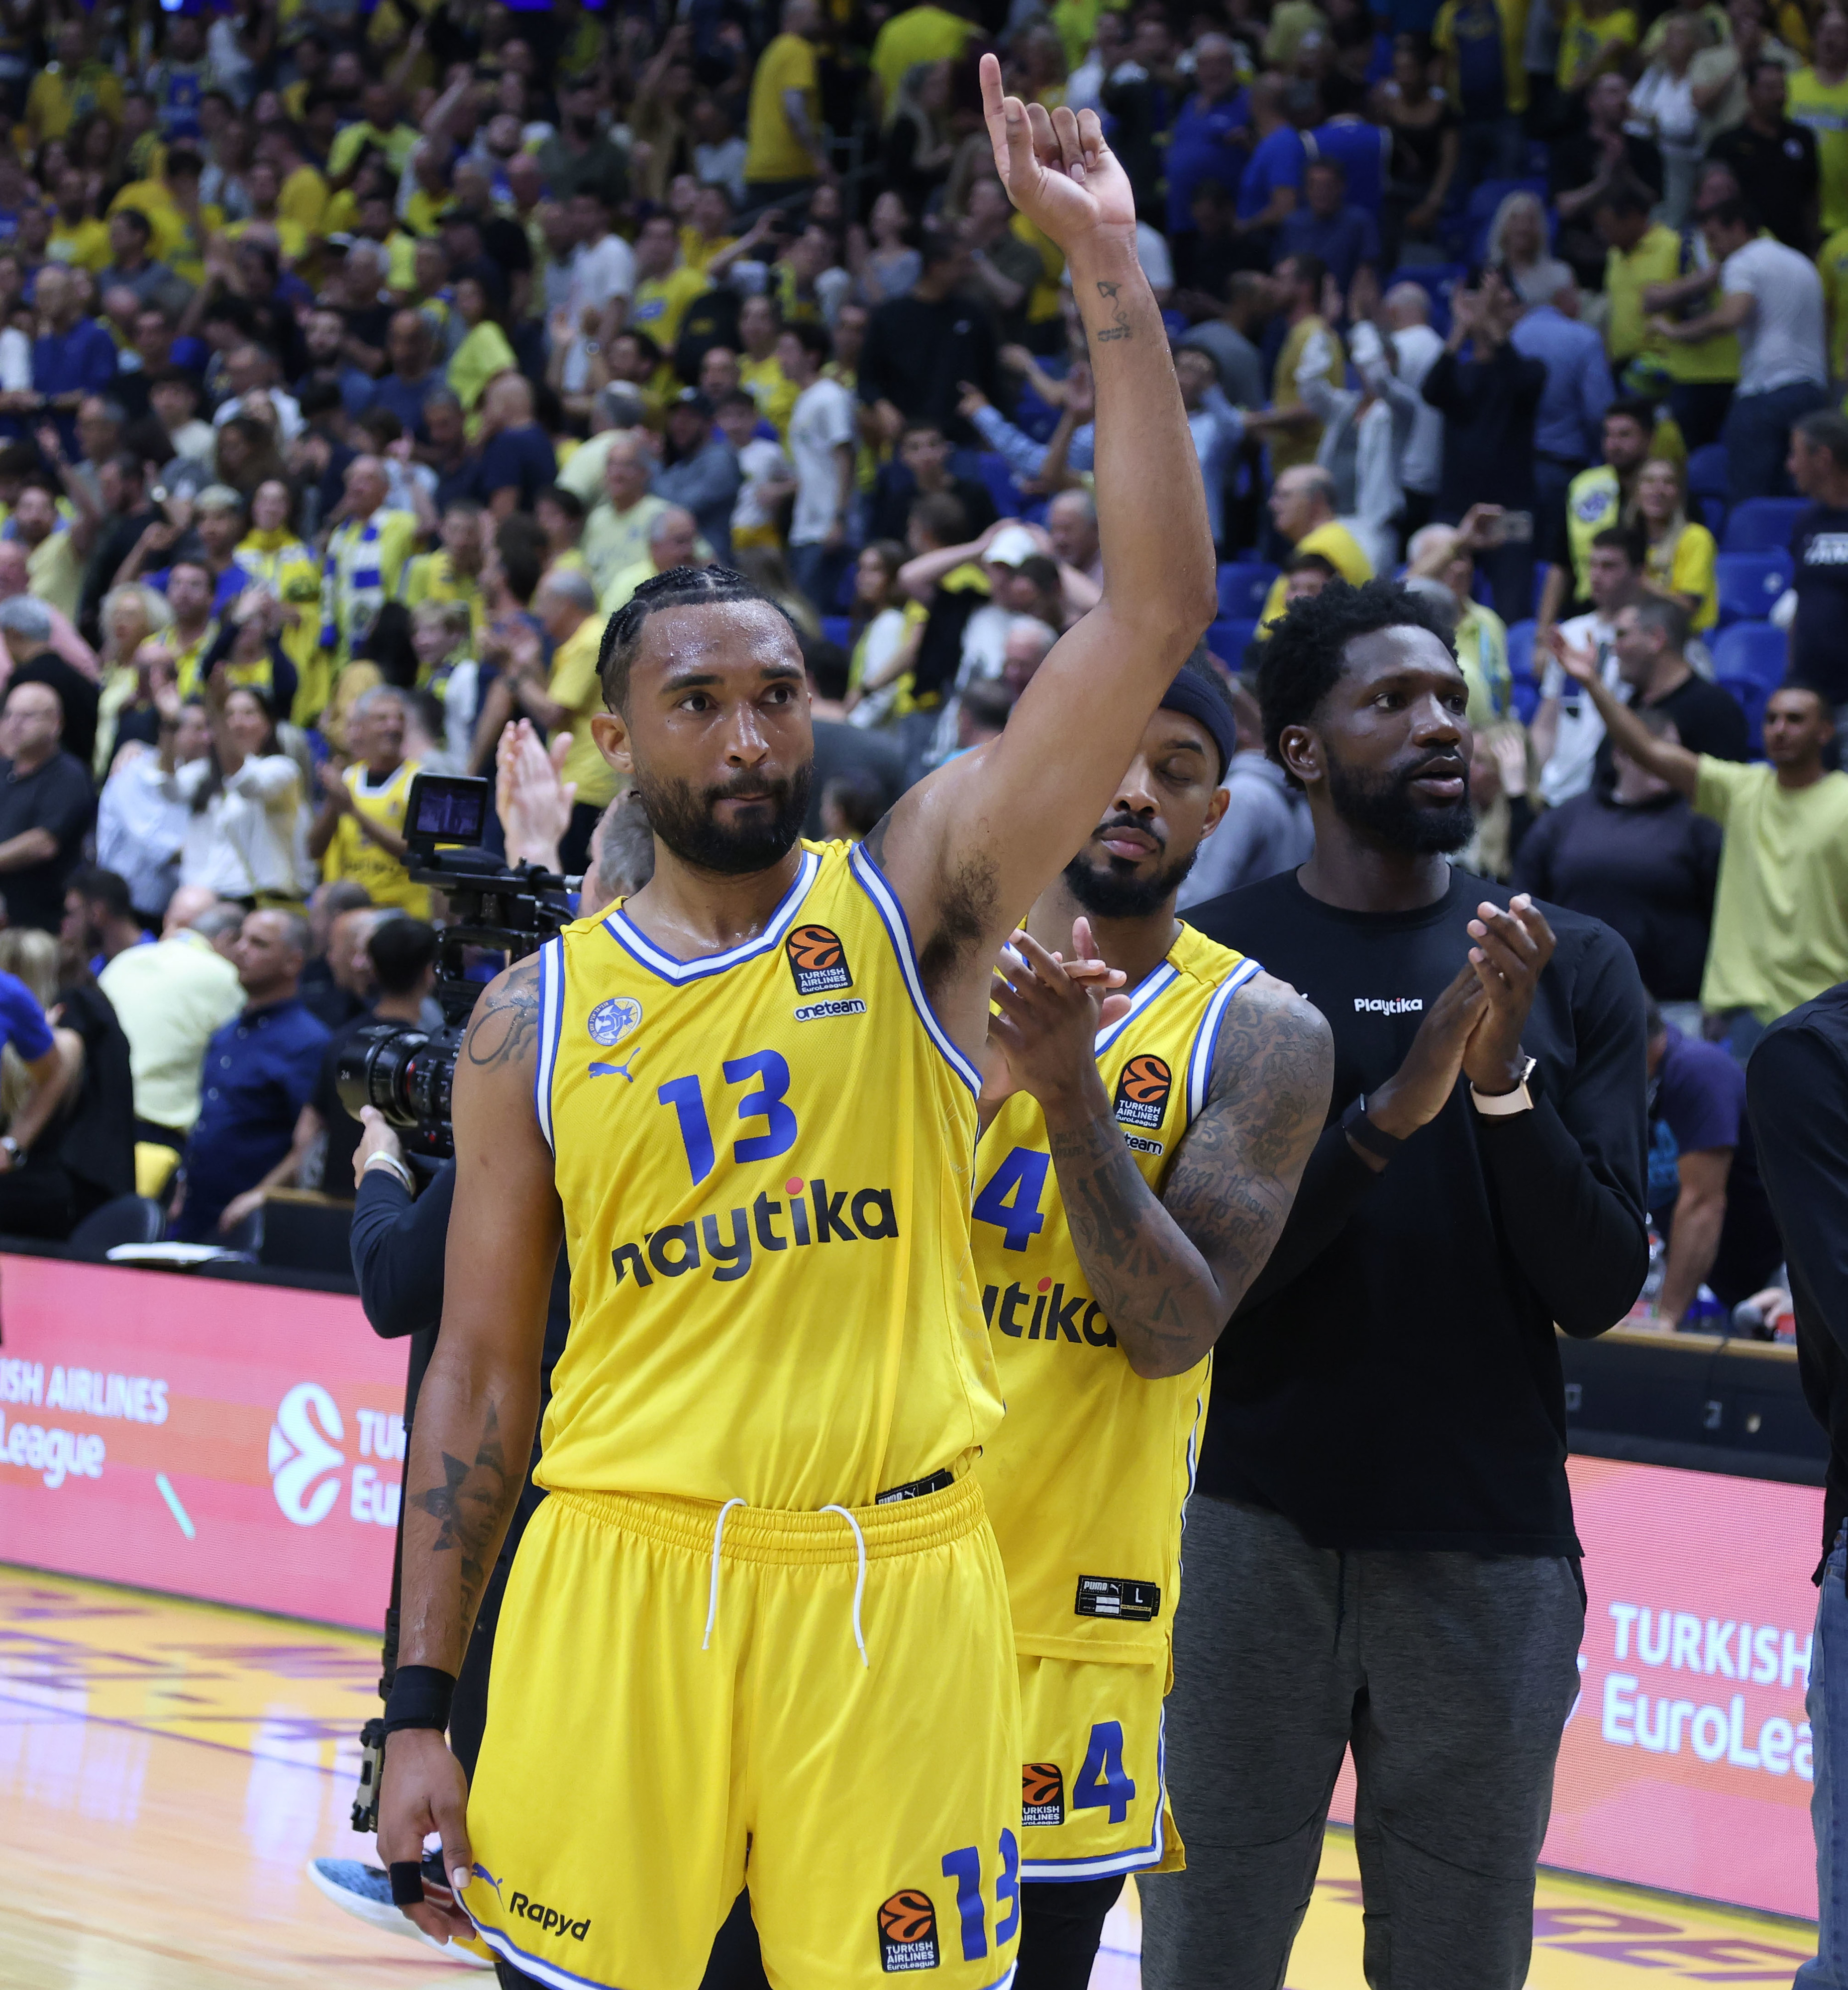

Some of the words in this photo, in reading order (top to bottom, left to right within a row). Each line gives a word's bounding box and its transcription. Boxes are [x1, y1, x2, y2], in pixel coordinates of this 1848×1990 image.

[799, 968, 844, 980] TURKISH
[801, 975, 846, 987] AIRLINES
[802, 982, 848, 993] EuroLeague
[796, 1000, 864, 1019] oneteam
[1354, 997, 1423, 1016] Playtika
[1117, 1108, 1158, 1121] AIRLINES
[1120, 1100, 1161, 1114] TURKISH
[658, 1049, 797, 1186] 13
[1116, 1114, 1157, 1127] EuroLeague
[972, 1146, 1050, 1252] 4
[46, 1365, 169, 1426] AIRLINES
[356, 1408, 407, 1461] TU
[1084, 1581, 1108, 1591] PUMA
[1135, 1588, 1143, 1603] L
[1609, 1600, 1813, 1692] TURKISH
[1073, 1720, 1135, 1824] 4
[1023, 1805, 1059, 1814] URKISH
[941, 1828, 1020, 1962] 13
[510, 1891, 591, 1942] Rapyd
[886, 1941, 933, 1955] TURKISH
[887, 1951, 934, 1964] AIRLINES
[887, 1961, 934, 1971] EuroLeague
